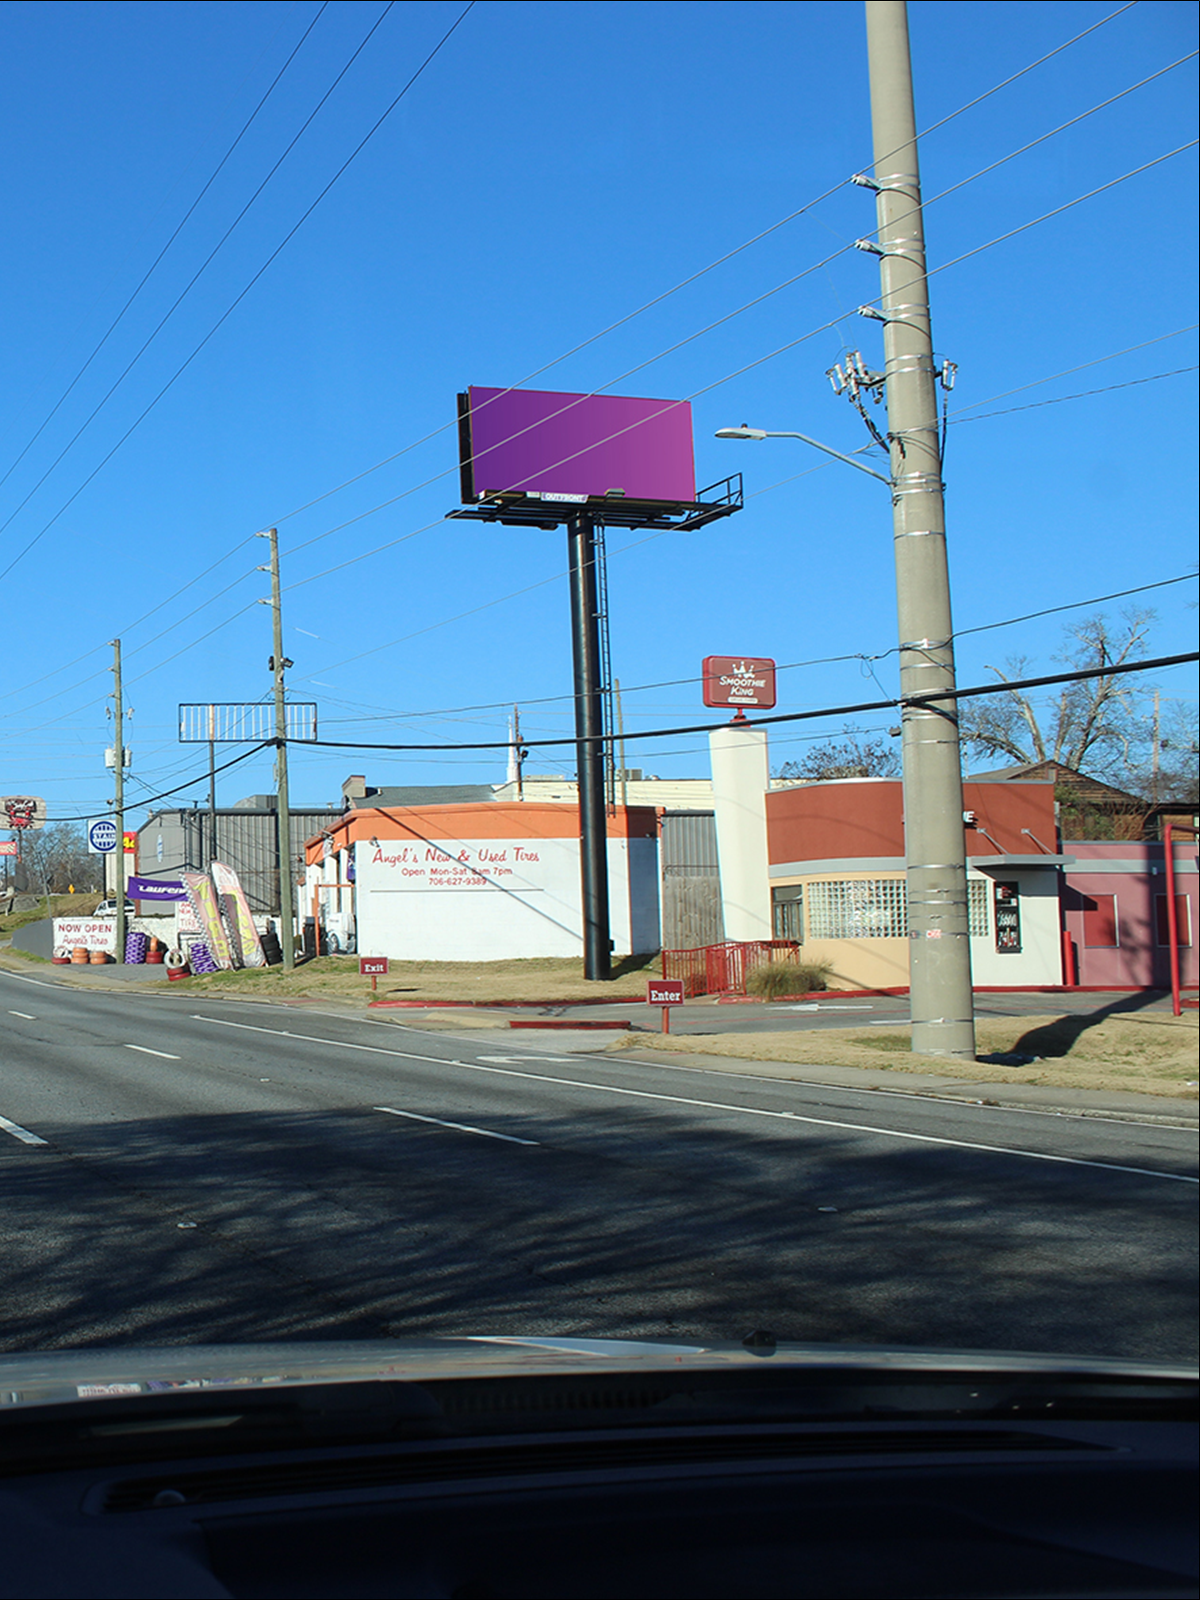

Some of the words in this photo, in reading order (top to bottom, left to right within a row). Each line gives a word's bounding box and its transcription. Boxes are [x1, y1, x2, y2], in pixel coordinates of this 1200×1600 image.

[719, 675, 766, 688] SMOOTHIE
[730, 686, 754, 696] KING
[372, 848, 419, 868] Angel's
[424, 848, 451, 863] New
[457, 849, 471, 862] &
[478, 849, 508, 863] Used
[513, 847, 540, 862] Tires
[401, 867, 426, 877] Open
[430, 867, 468, 876] Mon-Sat
[493, 867, 513, 877] 7pm
[58, 924, 82, 933] NOW
[84, 924, 112, 933] OPEN
[364, 964, 385, 972] Exit
[650, 989, 681, 1001] Enter
